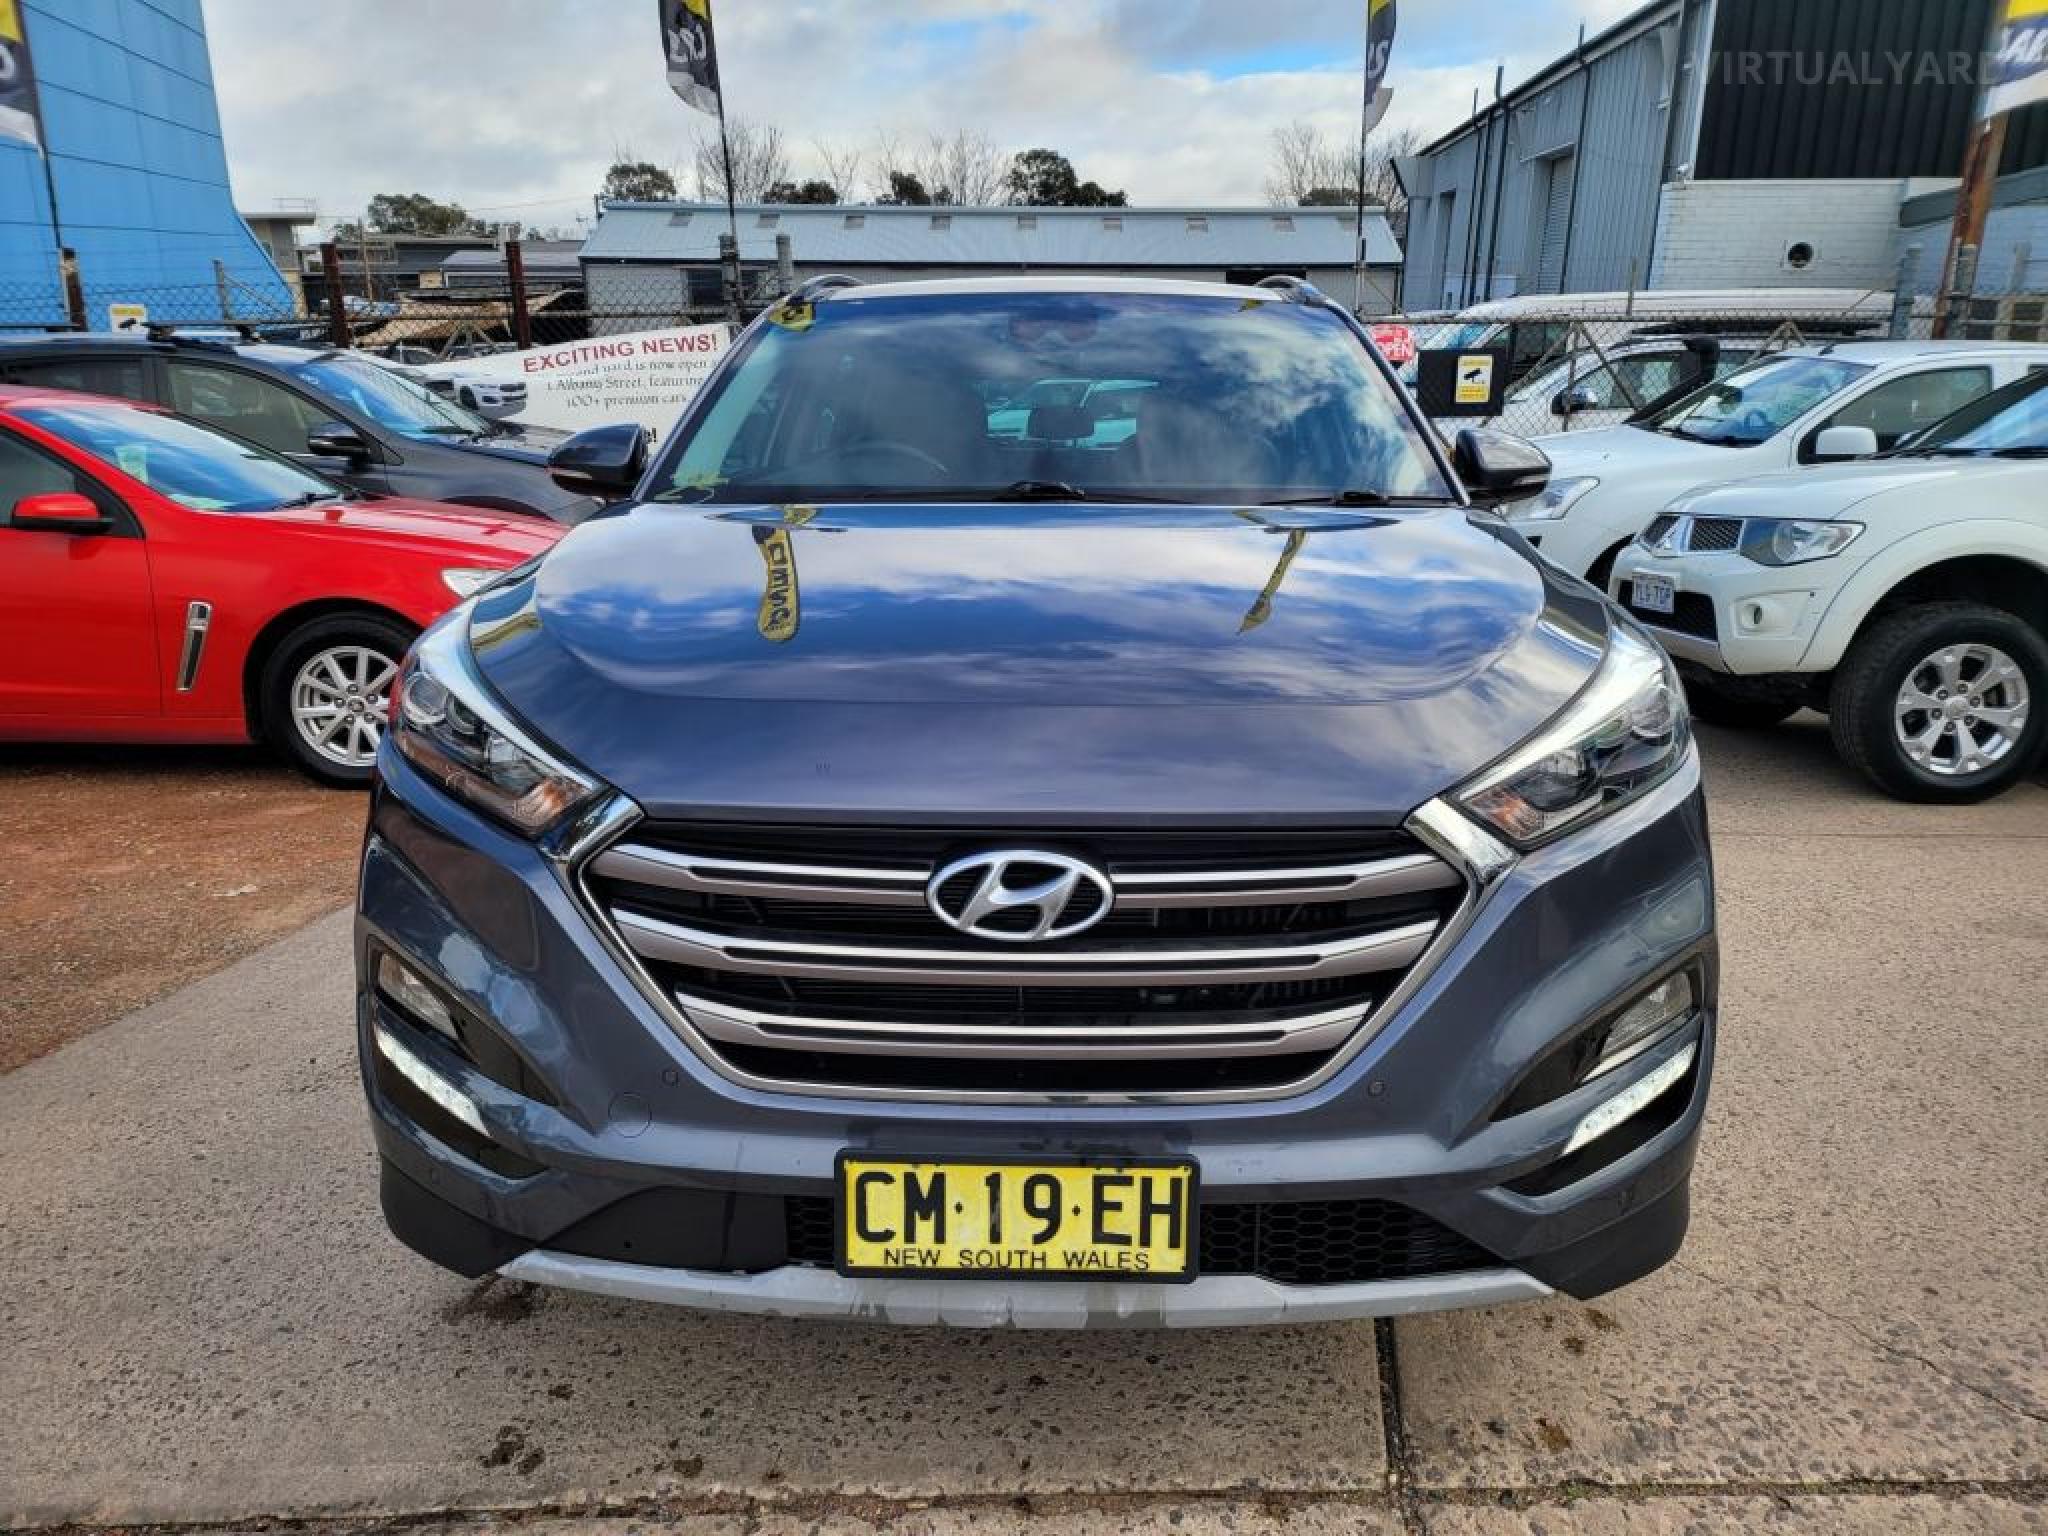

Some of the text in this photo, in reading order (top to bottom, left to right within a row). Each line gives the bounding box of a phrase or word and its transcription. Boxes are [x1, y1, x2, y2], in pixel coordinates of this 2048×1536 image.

[523, 333, 718, 373] EXCITING NEWS!
[649, 361, 675, 370] now
[678, 360, 707, 373] open
[603, 393, 659, 411] premium
[883, 1248, 1150, 1271] NEW SOUTH WALES
